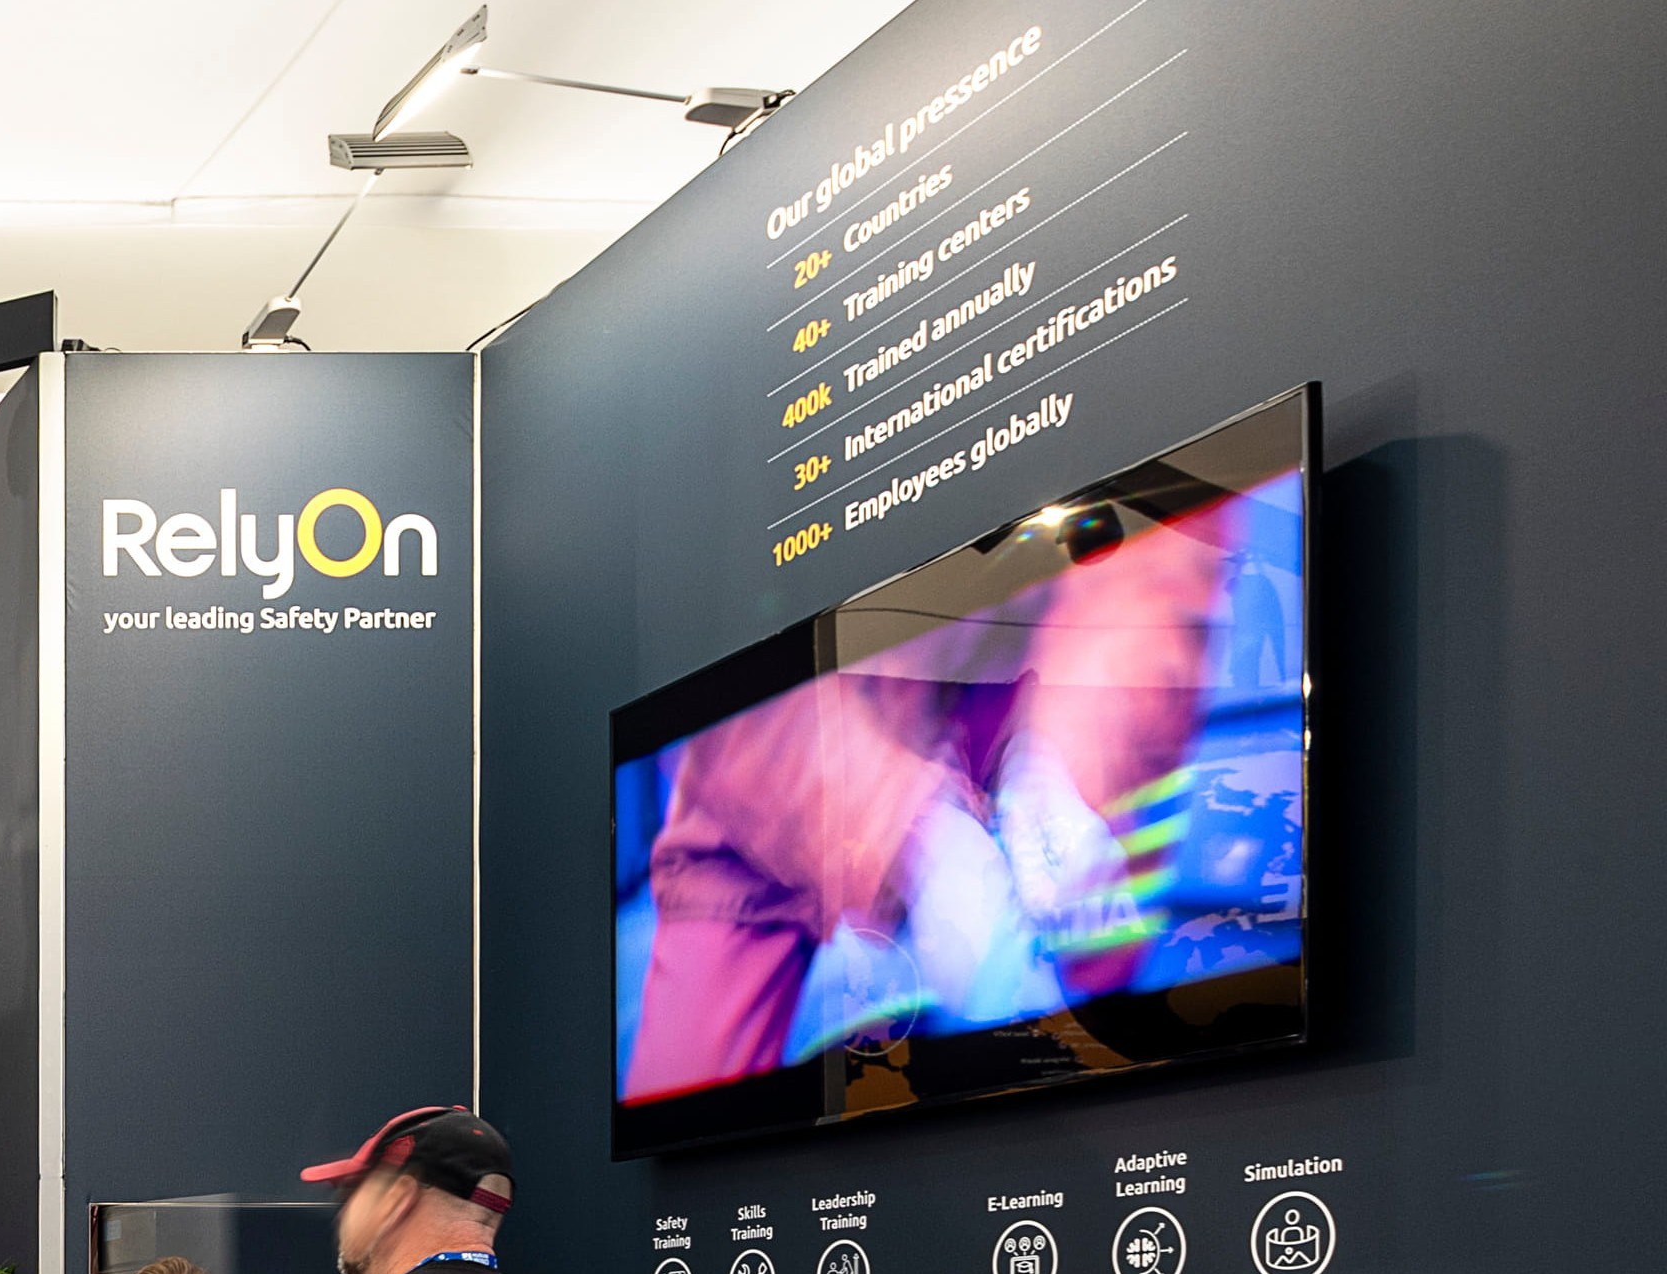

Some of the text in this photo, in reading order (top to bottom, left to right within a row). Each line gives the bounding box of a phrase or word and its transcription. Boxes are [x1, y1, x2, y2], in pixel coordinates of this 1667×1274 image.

[767, 24, 1042, 241] Our global pressence
[793, 163, 953, 289] 20+ Countries
[793, 187, 1031, 355] 40+ Training centers
[781, 260, 1036, 429] 400k Trained annually
[793, 254, 1178, 491] 30+ International certifications
[772, 391, 1075, 568] 1000+ Employees globally
[101, 487, 438, 600] RelyOn
[103, 606, 437, 634] your leading Safety Partner
[1115, 1150, 1187, 1173] Adaptive
[1244, 1157, 1343, 1183] Simulation
[1116, 1175, 1186, 1197] Learning
[812, 1190, 876, 1211] Leadership
[987, 1190, 1064, 1213] E-Learning
[656, 1216, 688, 1231] Safety
[738, 1205, 766, 1221] Skills
[820, 1213, 867, 1231] Training
[653, 1235, 691, 1250] Training
[731, 1225, 773, 1241] Training
